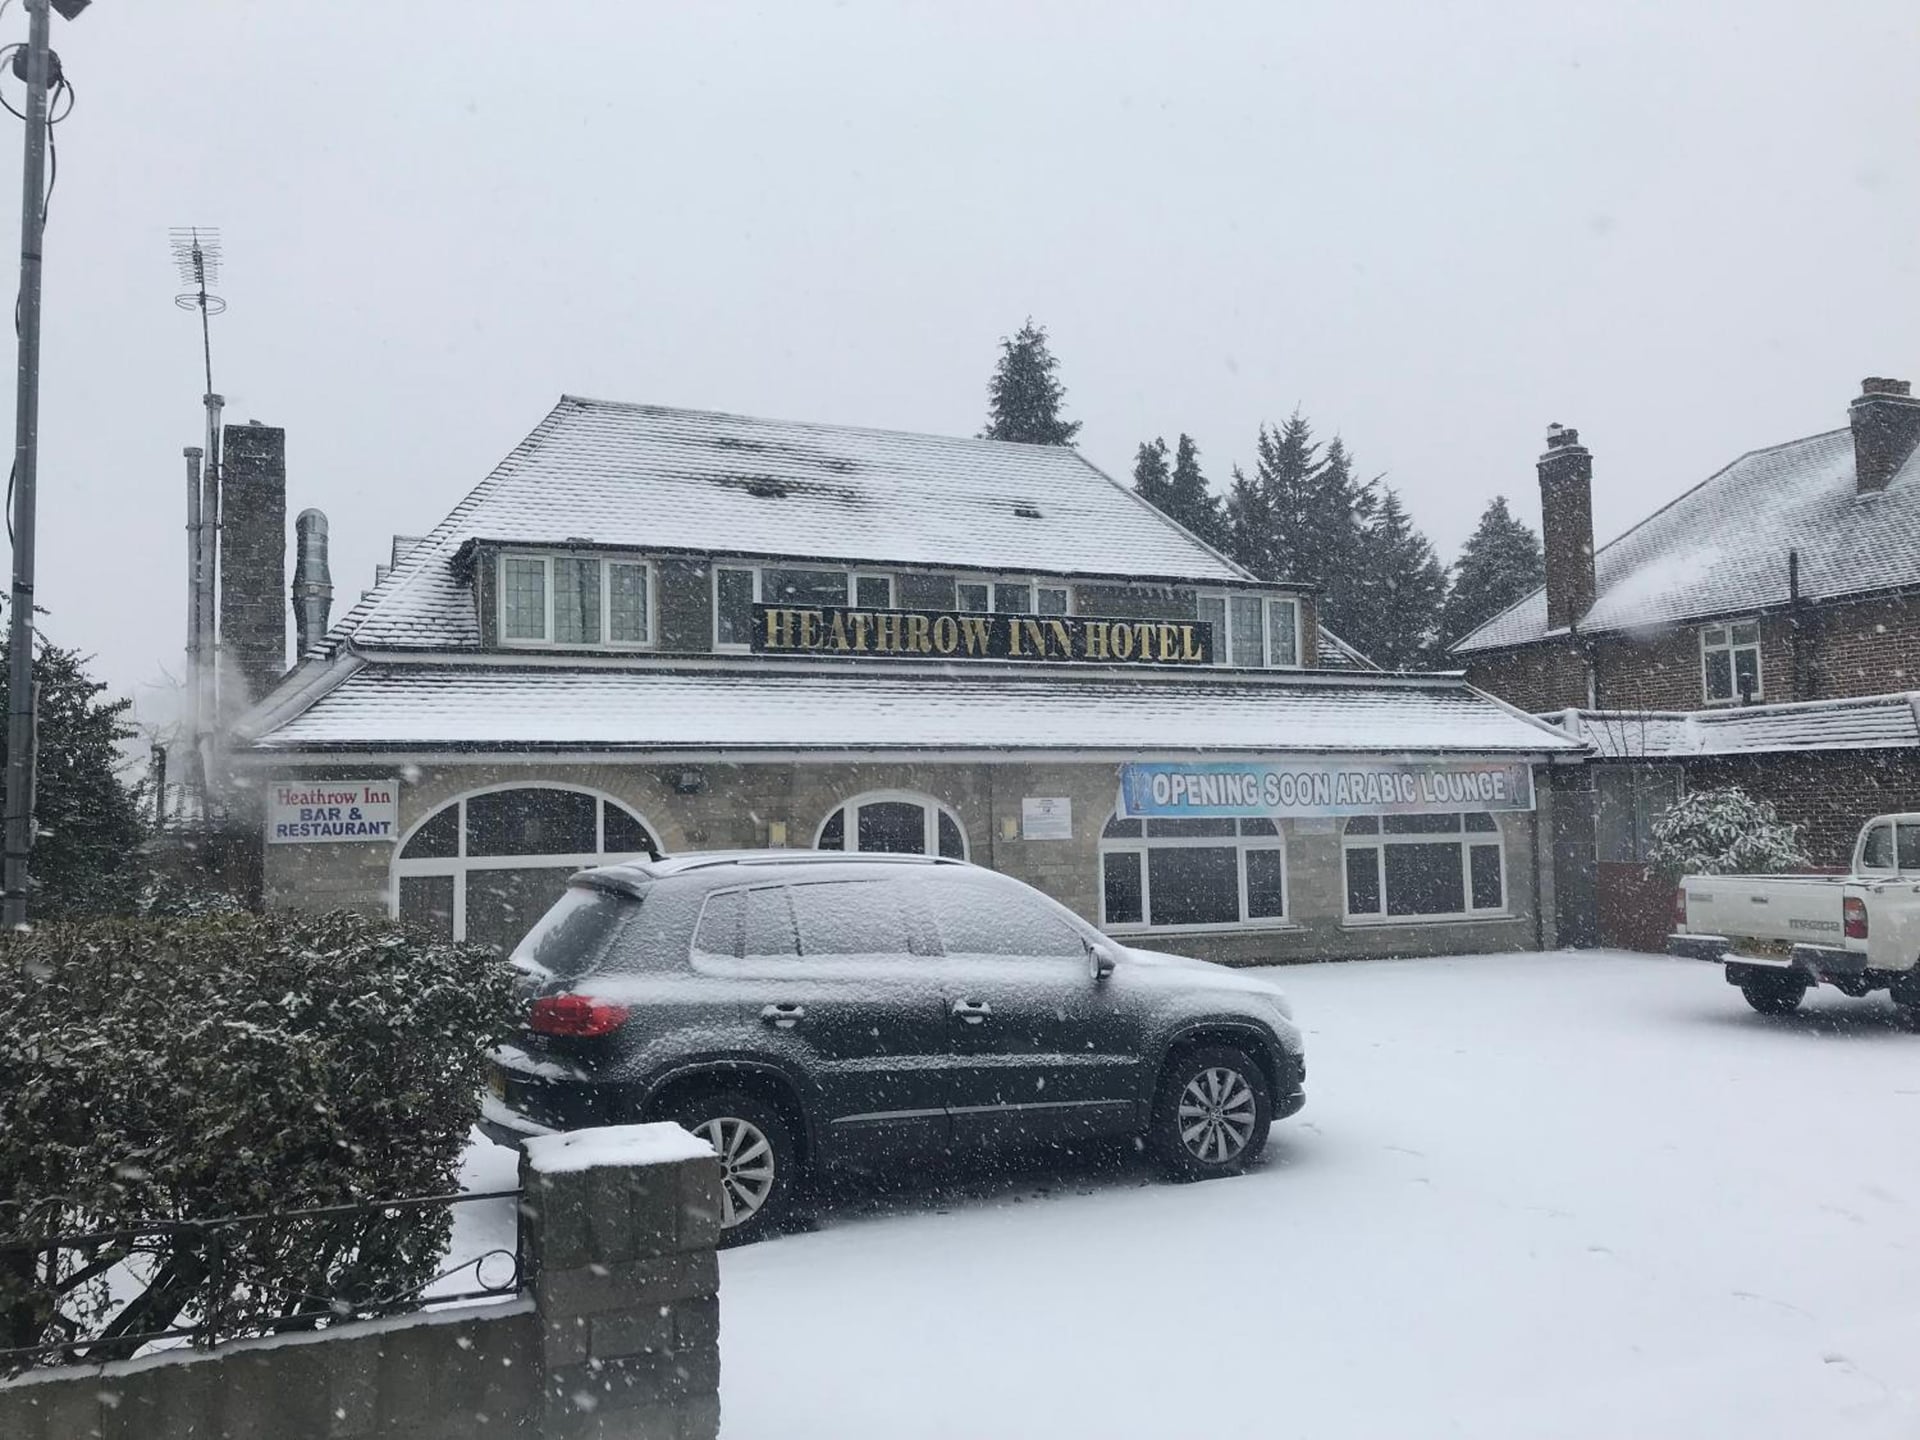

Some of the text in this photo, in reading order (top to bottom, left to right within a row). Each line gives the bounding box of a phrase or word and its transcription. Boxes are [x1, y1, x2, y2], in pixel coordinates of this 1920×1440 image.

[764, 608, 1202, 662] HEATHROW INN HOTEL
[277, 787, 391, 806] Heathrow Inn
[1151, 771, 1506, 807] OPENING SOON ARABIC LOUNGE
[300, 807, 362, 822] BAR &
[276, 821, 391, 838] RESTAURANT
